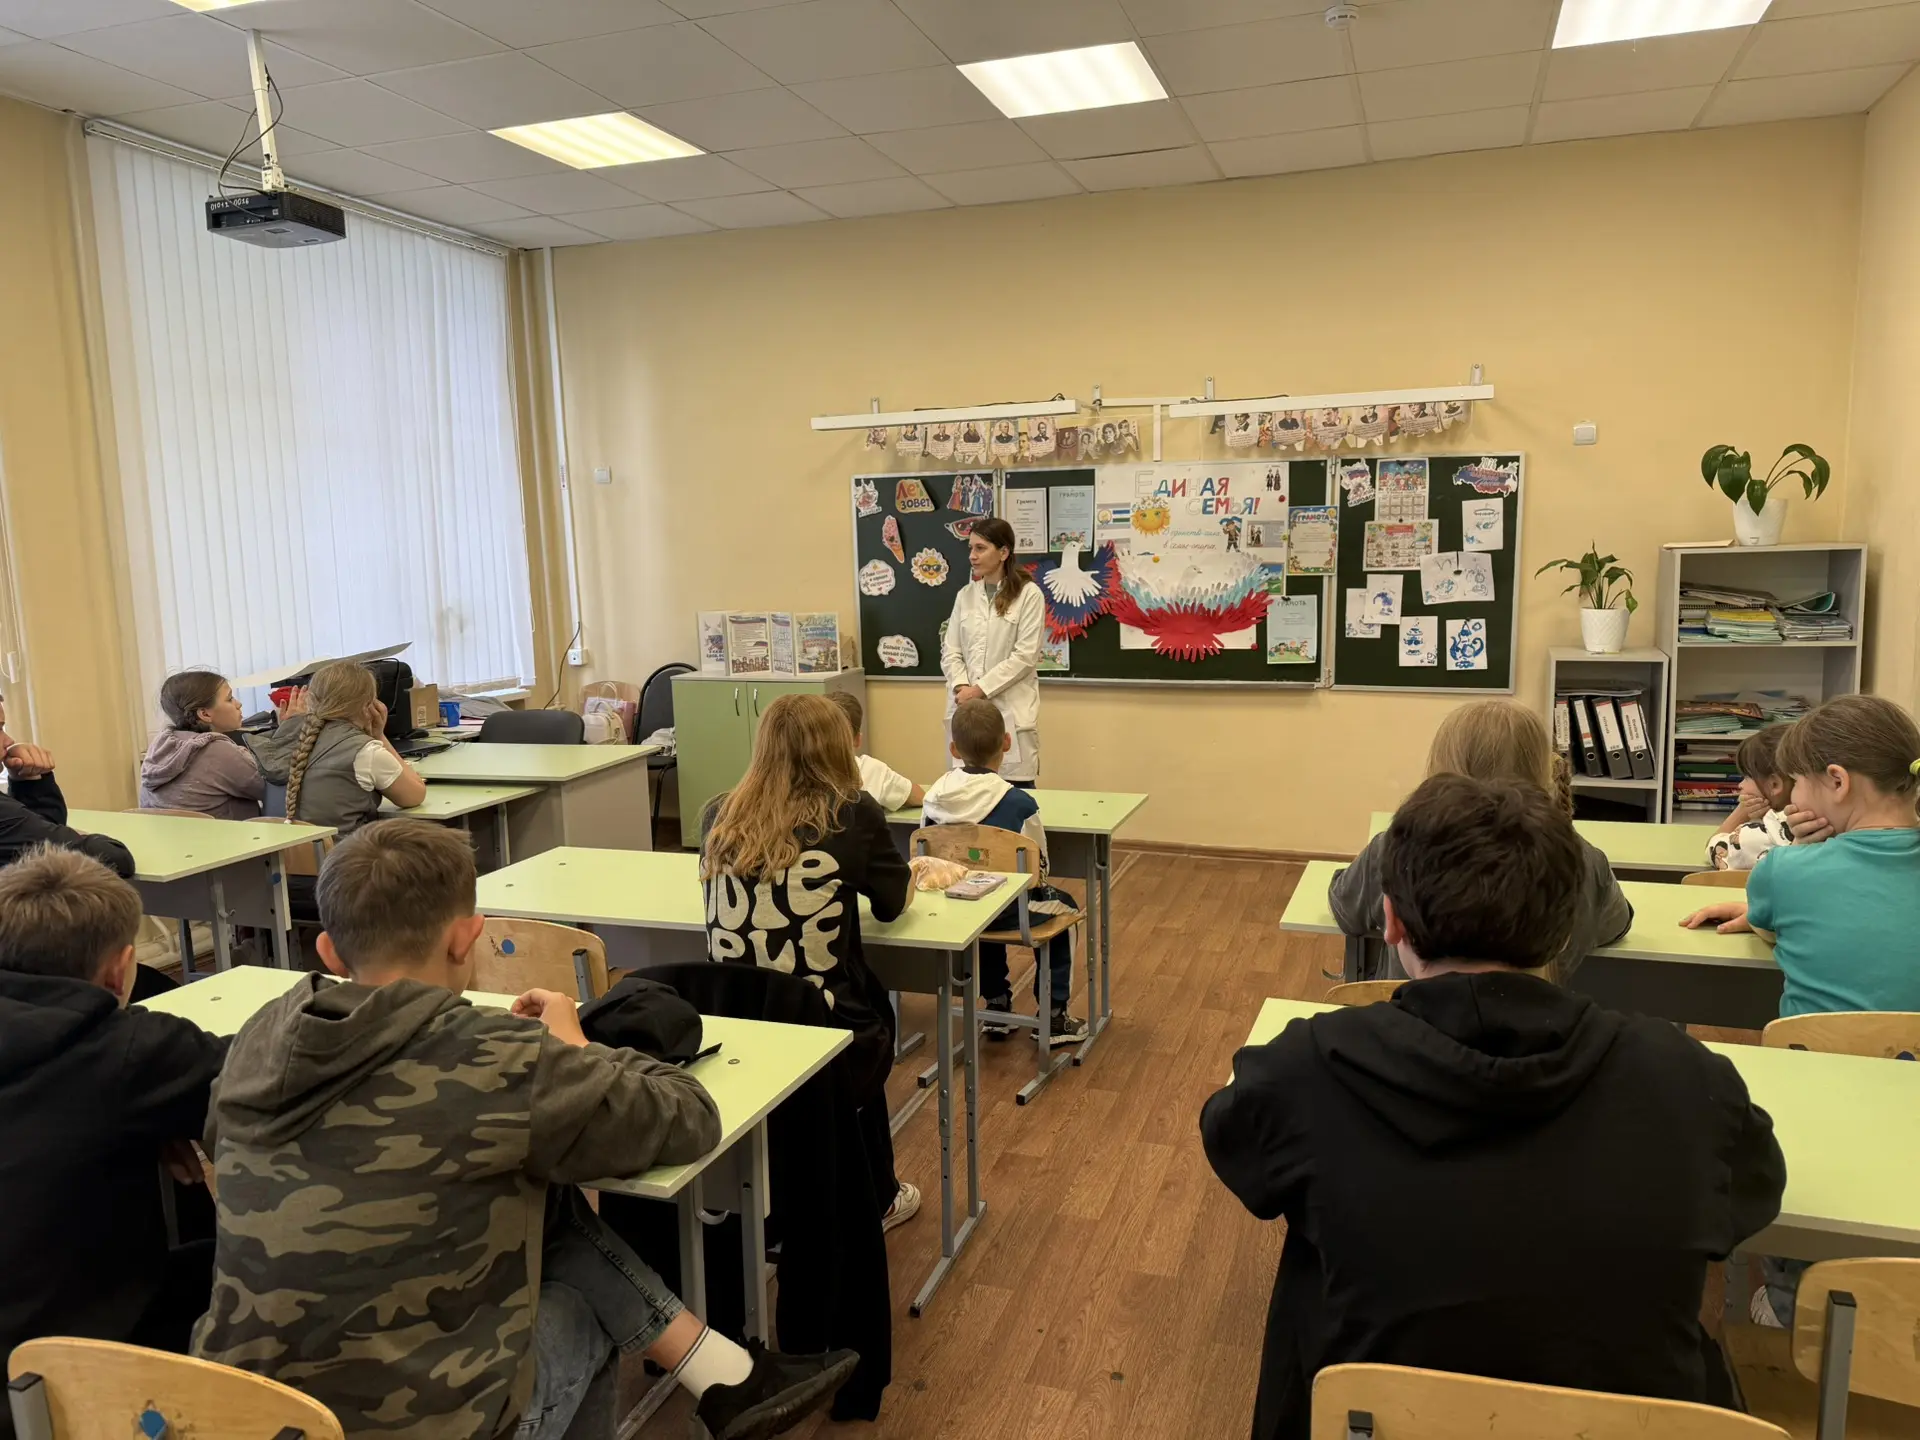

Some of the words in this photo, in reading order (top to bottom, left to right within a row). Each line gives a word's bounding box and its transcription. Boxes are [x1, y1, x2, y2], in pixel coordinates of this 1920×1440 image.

[1135, 470, 1230, 498] ЕДИНАЯ
[1185, 497, 1261, 516] СЕМЬЯ!
[1297, 513, 1330, 521] ГРАМОТА
